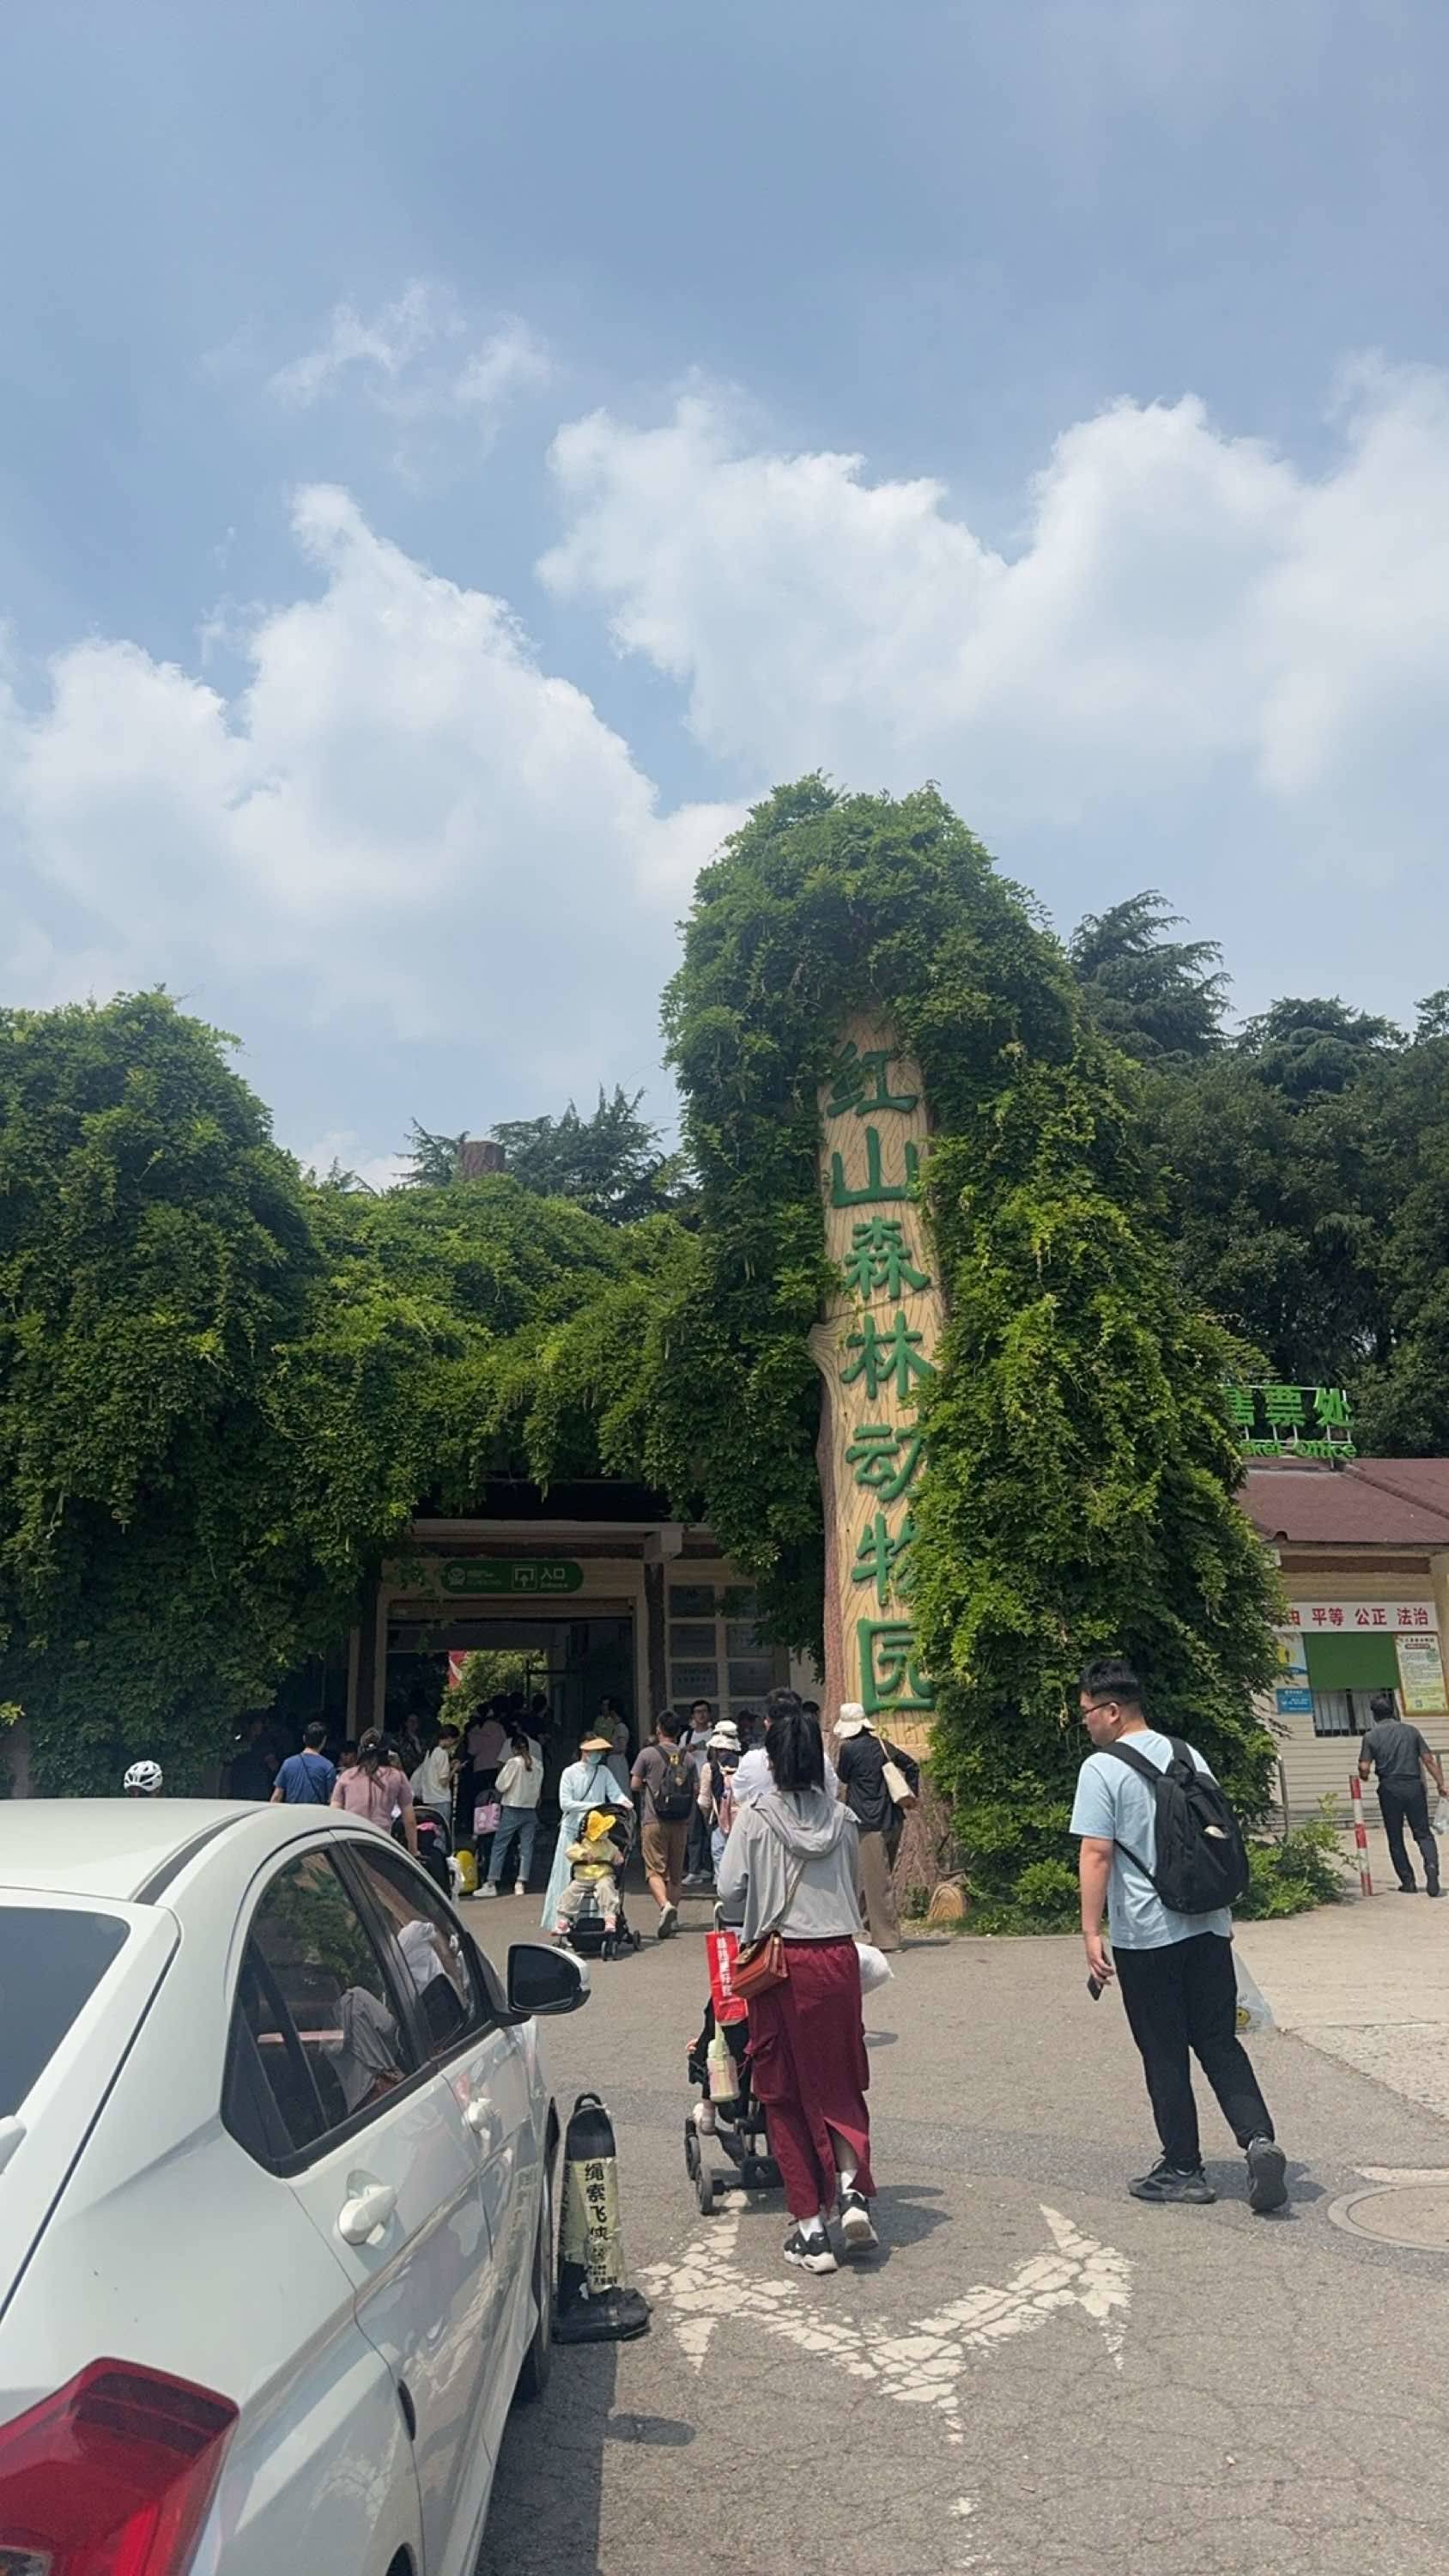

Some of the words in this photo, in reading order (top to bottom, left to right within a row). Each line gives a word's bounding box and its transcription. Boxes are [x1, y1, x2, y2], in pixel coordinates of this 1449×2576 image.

[827, 1041, 937, 1716] 红山森林动物园
[1294, 1443, 1358, 1458] Office
[540, 1567, 565, 1580] 入口
[1312, 1607, 1345, 1626] 平等
[1355, 1607, 1388, 1626] 公正
[1397, 1607, 1429, 1626] 法治
